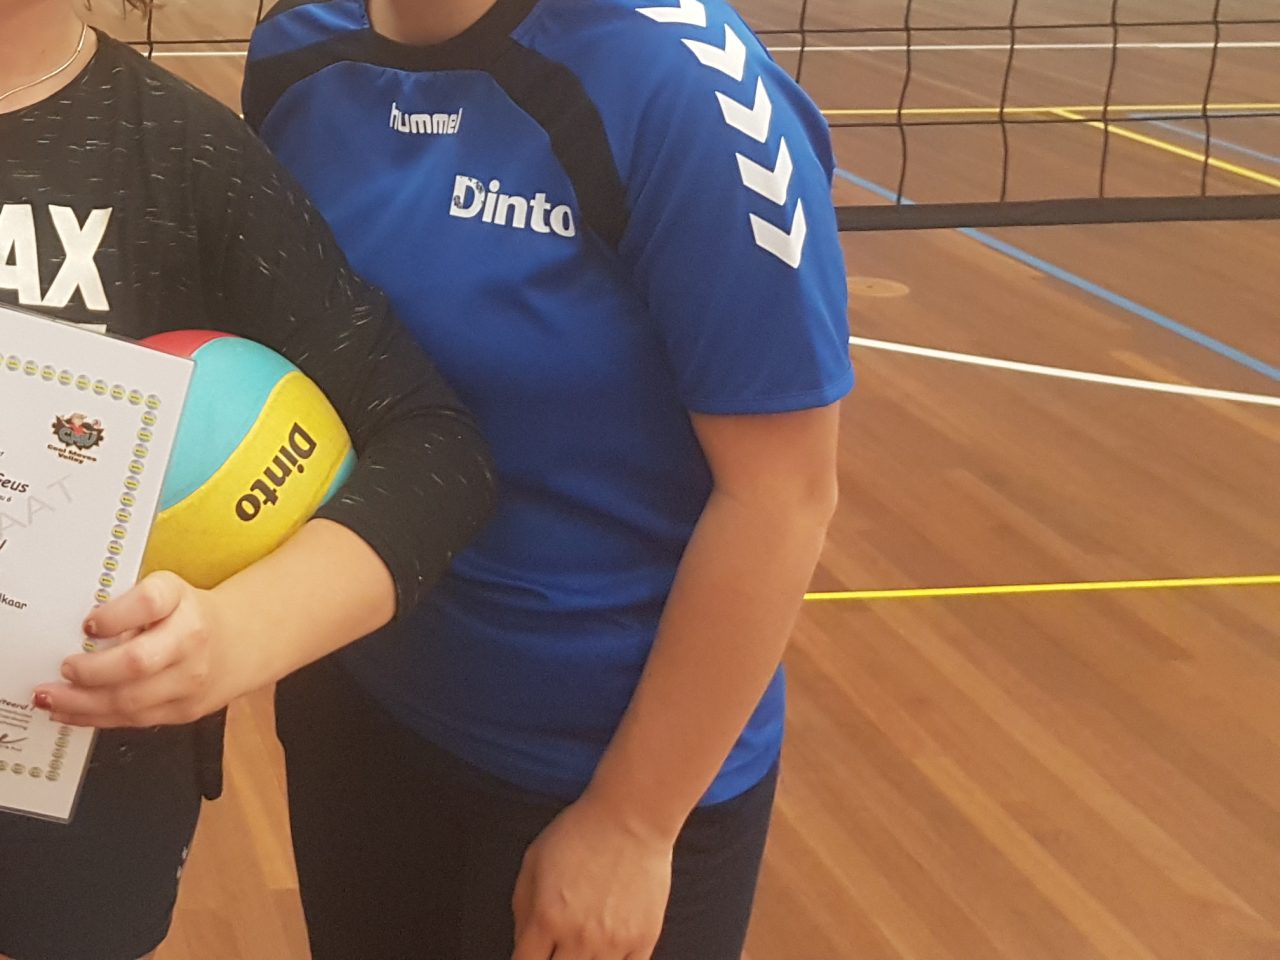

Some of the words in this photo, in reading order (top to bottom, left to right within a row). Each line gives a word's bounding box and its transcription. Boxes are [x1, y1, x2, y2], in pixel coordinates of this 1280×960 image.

[389, 102, 463, 135] hummel
[449, 174, 576, 237] Dinto
[235, 421, 317, 522] Dinto
